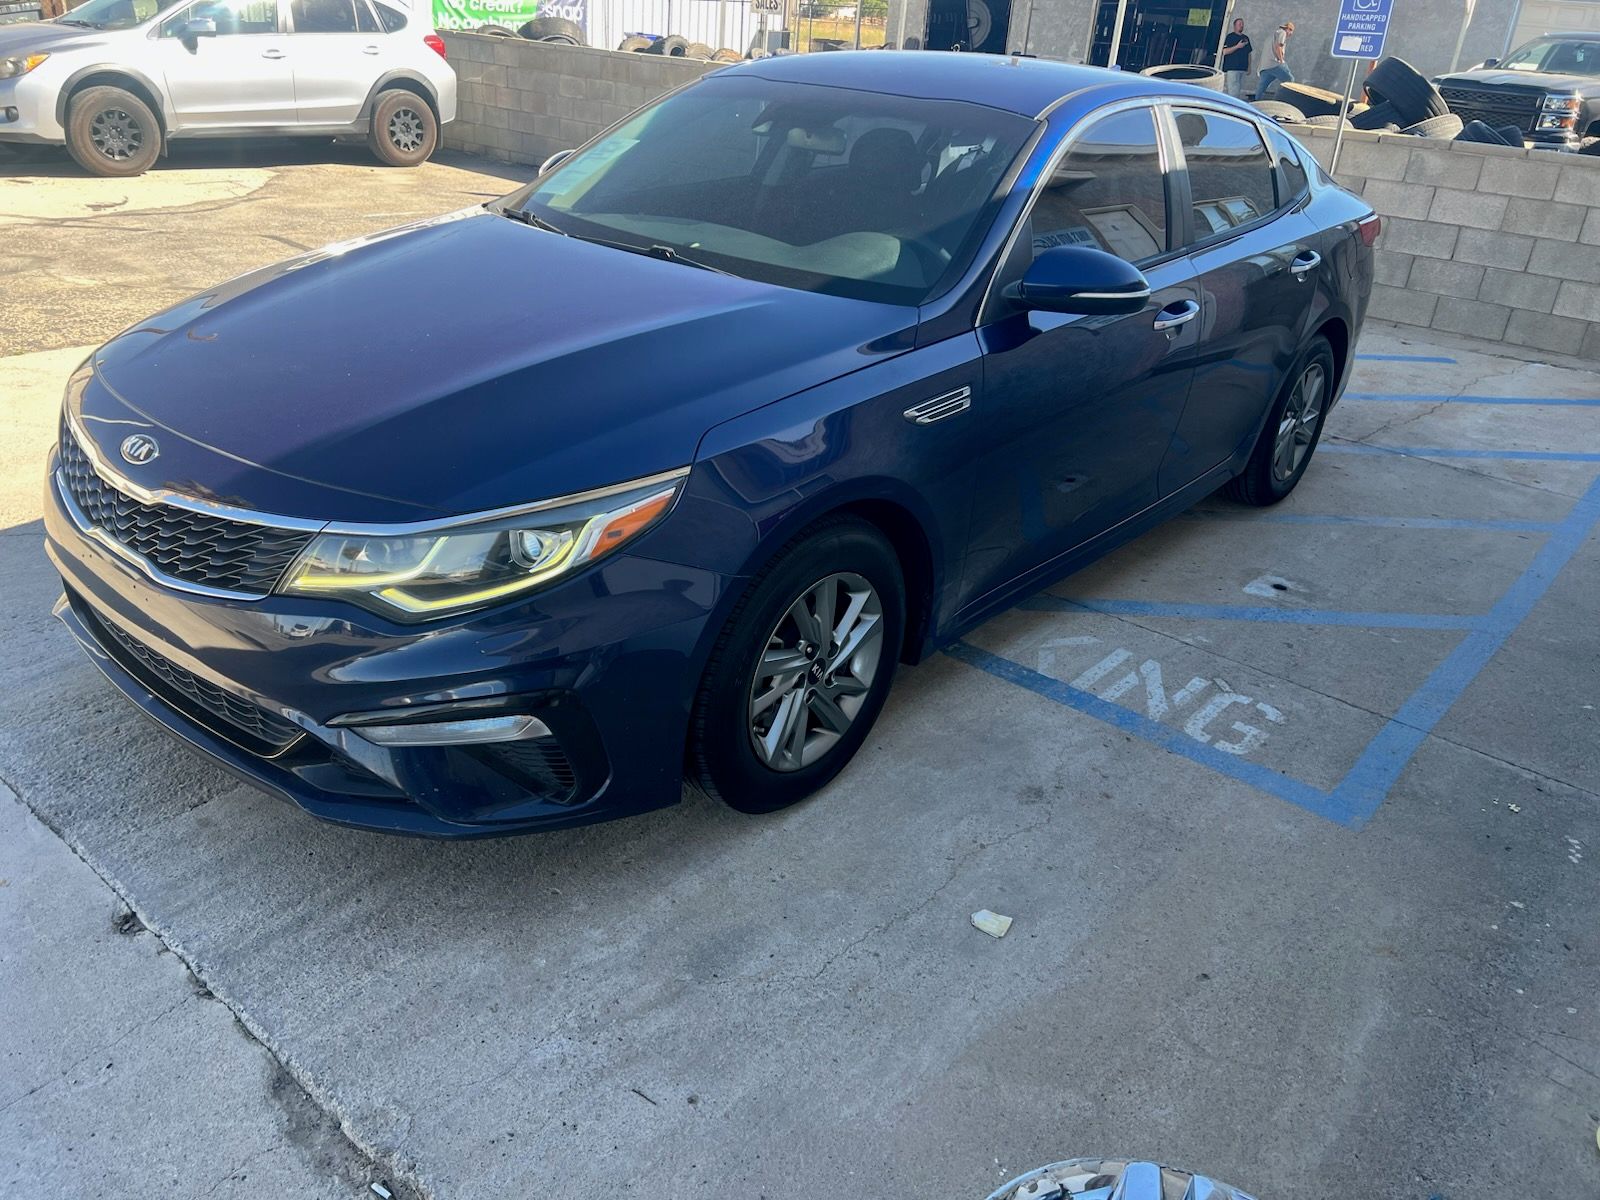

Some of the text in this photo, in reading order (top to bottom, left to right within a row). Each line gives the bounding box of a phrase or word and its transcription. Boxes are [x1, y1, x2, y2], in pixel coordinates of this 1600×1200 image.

[1341, 13, 1386, 22] HANDICAPPED
[1347, 22, 1376, 31] PARKING
[122, 436, 153, 460] KIA
[811, 664, 824, 680] KIA
